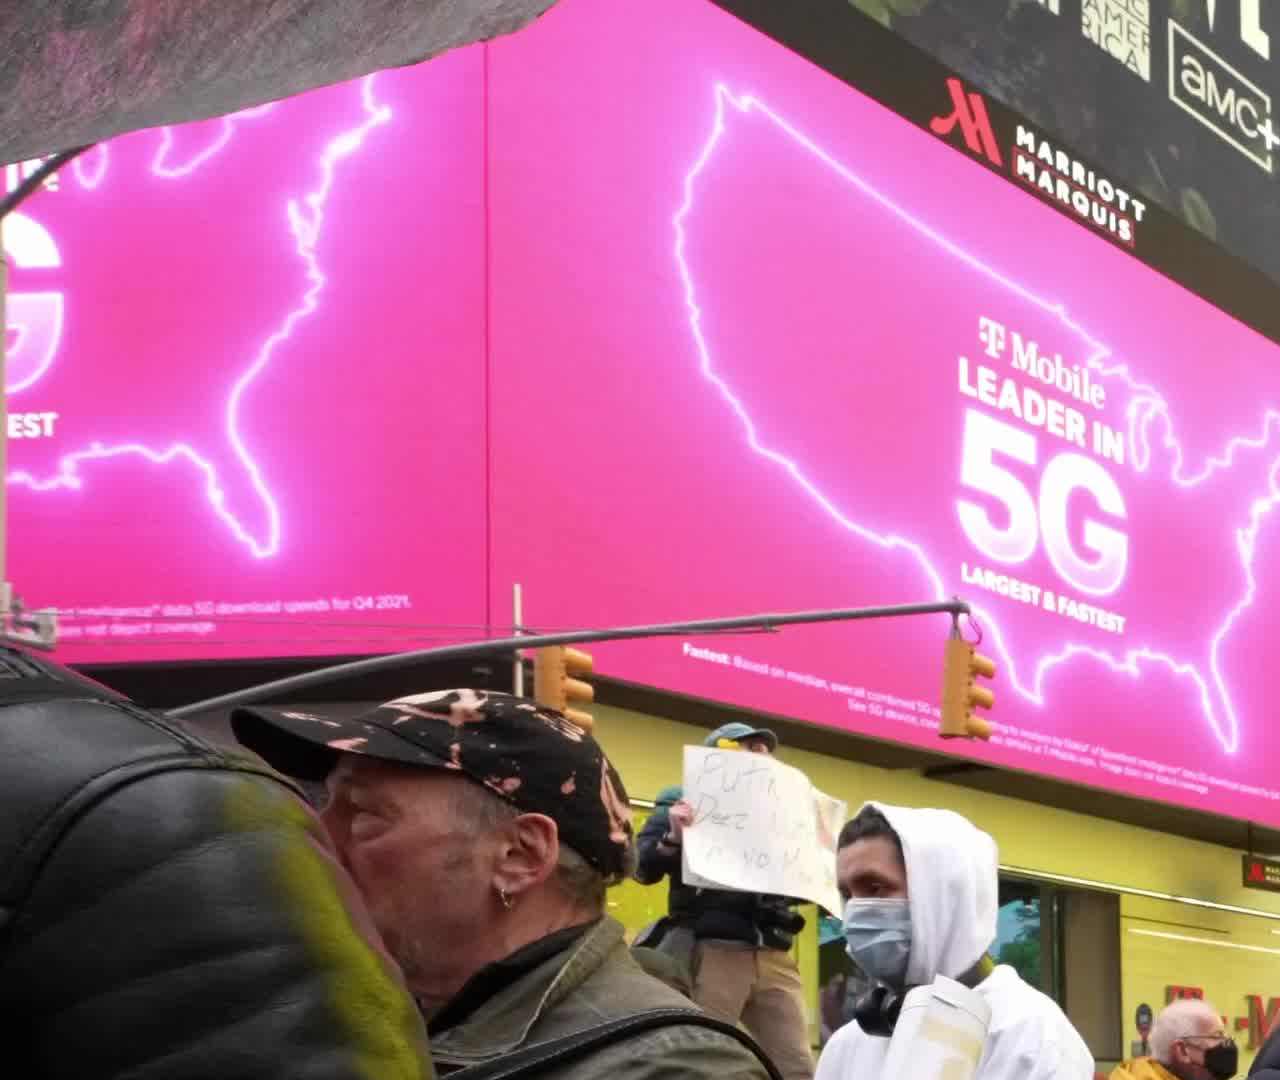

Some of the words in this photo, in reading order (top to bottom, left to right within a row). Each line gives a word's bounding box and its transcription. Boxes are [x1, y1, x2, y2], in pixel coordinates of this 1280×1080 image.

[1016, 125, 1146, 222] MARRIOTT
[1016, 154, 1132, 241] MARQUIS
[958, 356, 1087, 448] LEADER
[1093, 418, 1125, 465] IN
[1011, 331, 1105, 410] Mobile
[956, 408, 1129, 597] 5G
[961, 562, 1041, 607] LARGEST
[1043, 590, 1057, 613] &
[1058, 594, 1127, 634] FASTEST
